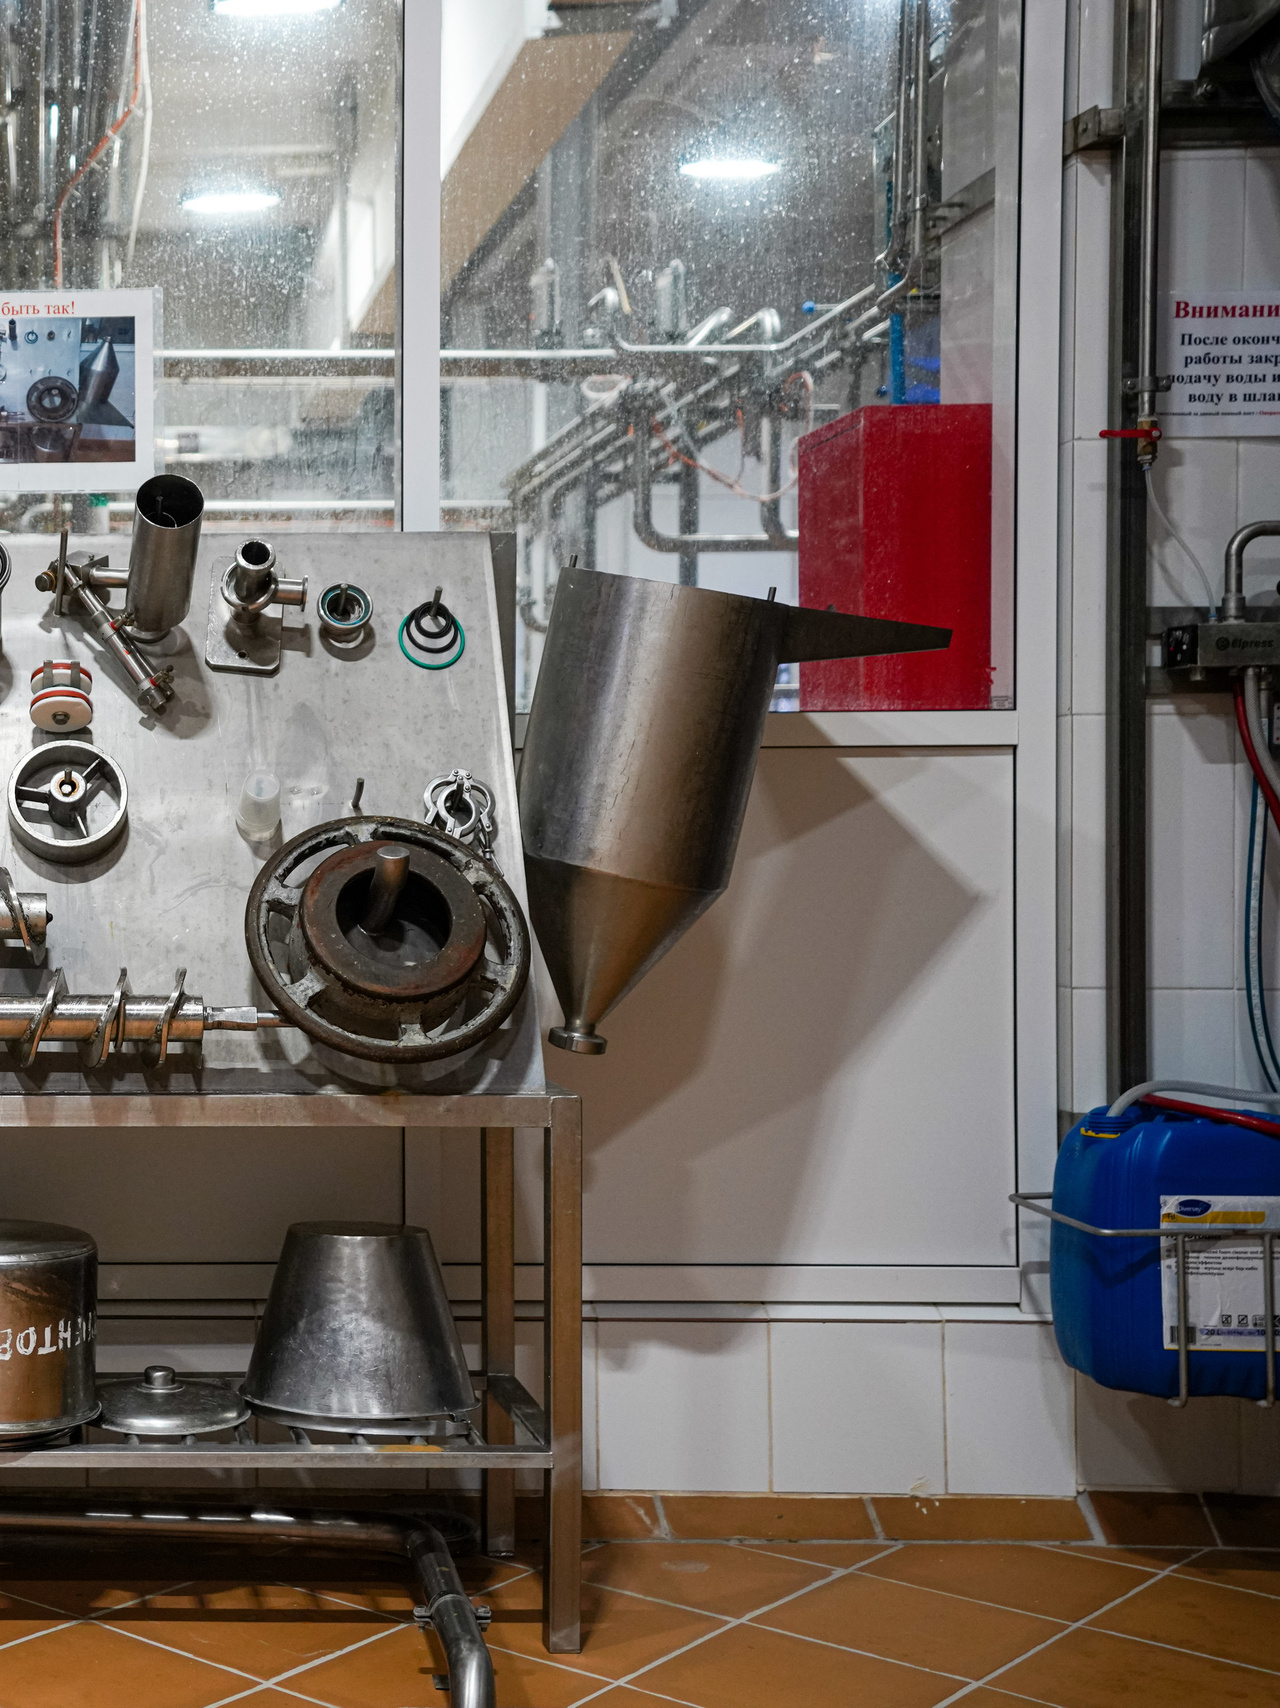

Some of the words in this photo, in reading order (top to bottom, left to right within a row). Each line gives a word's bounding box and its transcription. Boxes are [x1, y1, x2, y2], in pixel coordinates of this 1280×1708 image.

[1, 302, 39, 316] быть
[45, 301, 75, 315] так!
[1174, 300, 1280, 319] Внимани
[1180, 333, 1228, 346] После
[1184, 352, 1242, 368] работы
[1225, 373, 1267, 385] воды
[1188, 392, 1224, 406] воду
[1228, 393, 1238, 402] в
[1231, 637, 1274, 650] Elpress
[1177, 1205, 1202, 1214] Diversey
